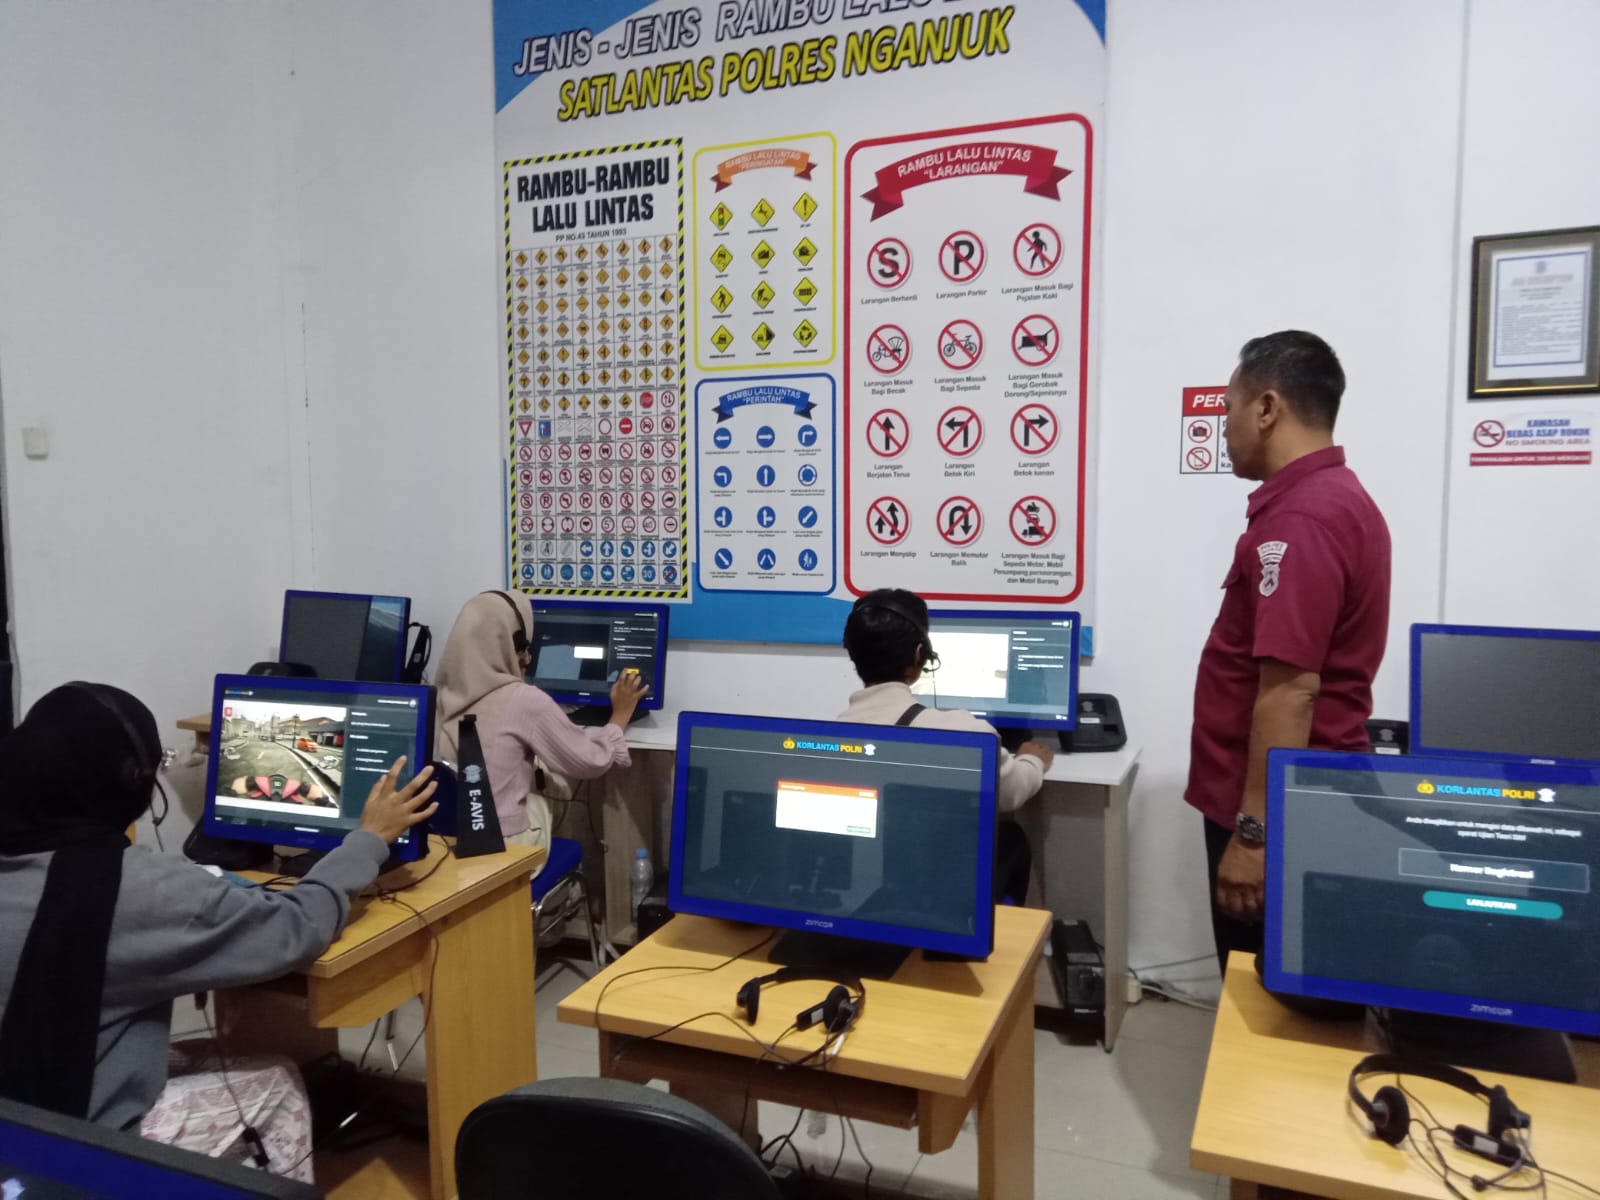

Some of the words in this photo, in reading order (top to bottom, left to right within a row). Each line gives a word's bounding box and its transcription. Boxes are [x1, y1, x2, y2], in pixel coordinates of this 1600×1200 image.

[513, 27, 594, 77] JENIS
[615, 7, 701, 59] JENIS
[715, 0, 833, 42] RAMBU
[558, 56, 714, 122] SATLANTAS
[720, 35, 837, 96] POLRES
[843, 4, 1015, 77] NGANJUK
[897, 150, 944, 177] RAMBU
[947, 147, 981, 161] LALU
[983, 147, 1032, 162] LINTAS
[923, 160, 1004, 180] "LARANGAN"
[517, 157, 669, 202] RAMBU-RAMBU
[532, 202, 576, 233] LALU
[585, 193, 654, 227] LINTAS
[556, 234, 565, 242] PP
[587, 230, 610, 240] TAHUN
[878, 247, 899, 278] S
[953, 240, 975, 275] P
[1001, 285, 1034, 296] Larangan
[1034, 283, 1057, 292] Masuk
[1058, 282, 1074, 292] Bagi
[860, 296, 890, 305] Larangan
[936, 290, 967, 300] Larangan
[934, 376, 964, 385] Larangan
[965, 374, 986, 382] Masuk
[1008, 373, 1040, 382] Larangan
[1040, 371, 1063, 379] Masuk
[864, 380, 892, 388] Larangan
[892, 378, 914, 386] Masuk
[940, 384, 955, 392] Bagi
[1012, 381, 1028, 390] Bagi
[727, 389, 753, 402] RAMBU
[754, 388, 774, 396] LALU
[774, 388, 801, 400] LINTAS
[872, 388, 886, 396] Bagi
[1536, 428, 1558, 437] ASAP
[1522, 438, 1564, 446] SMOKING
[874, 463, 903, 472] Larangan
[944, 462, 975, 470] Larangan
[1018, 461, 1050, 470] Larangan
[944, 470, 964, 478] Belok
[860, 550, 890, 558] Larangan
[930, 551, 960, 560] Larangan
[1001, 552, 1030, 560] Larangan
[1030, 552, 1050, 560] Masuk
[796, 740, 840, 752] KORLANTAS
[840, 744, 863, 754] POLRI
[1436, 784, 1500, 798] KORLANTAS
[1502, 788, 1536, 800] POLRI
[469, 789, 484, 831] E-AVIS
